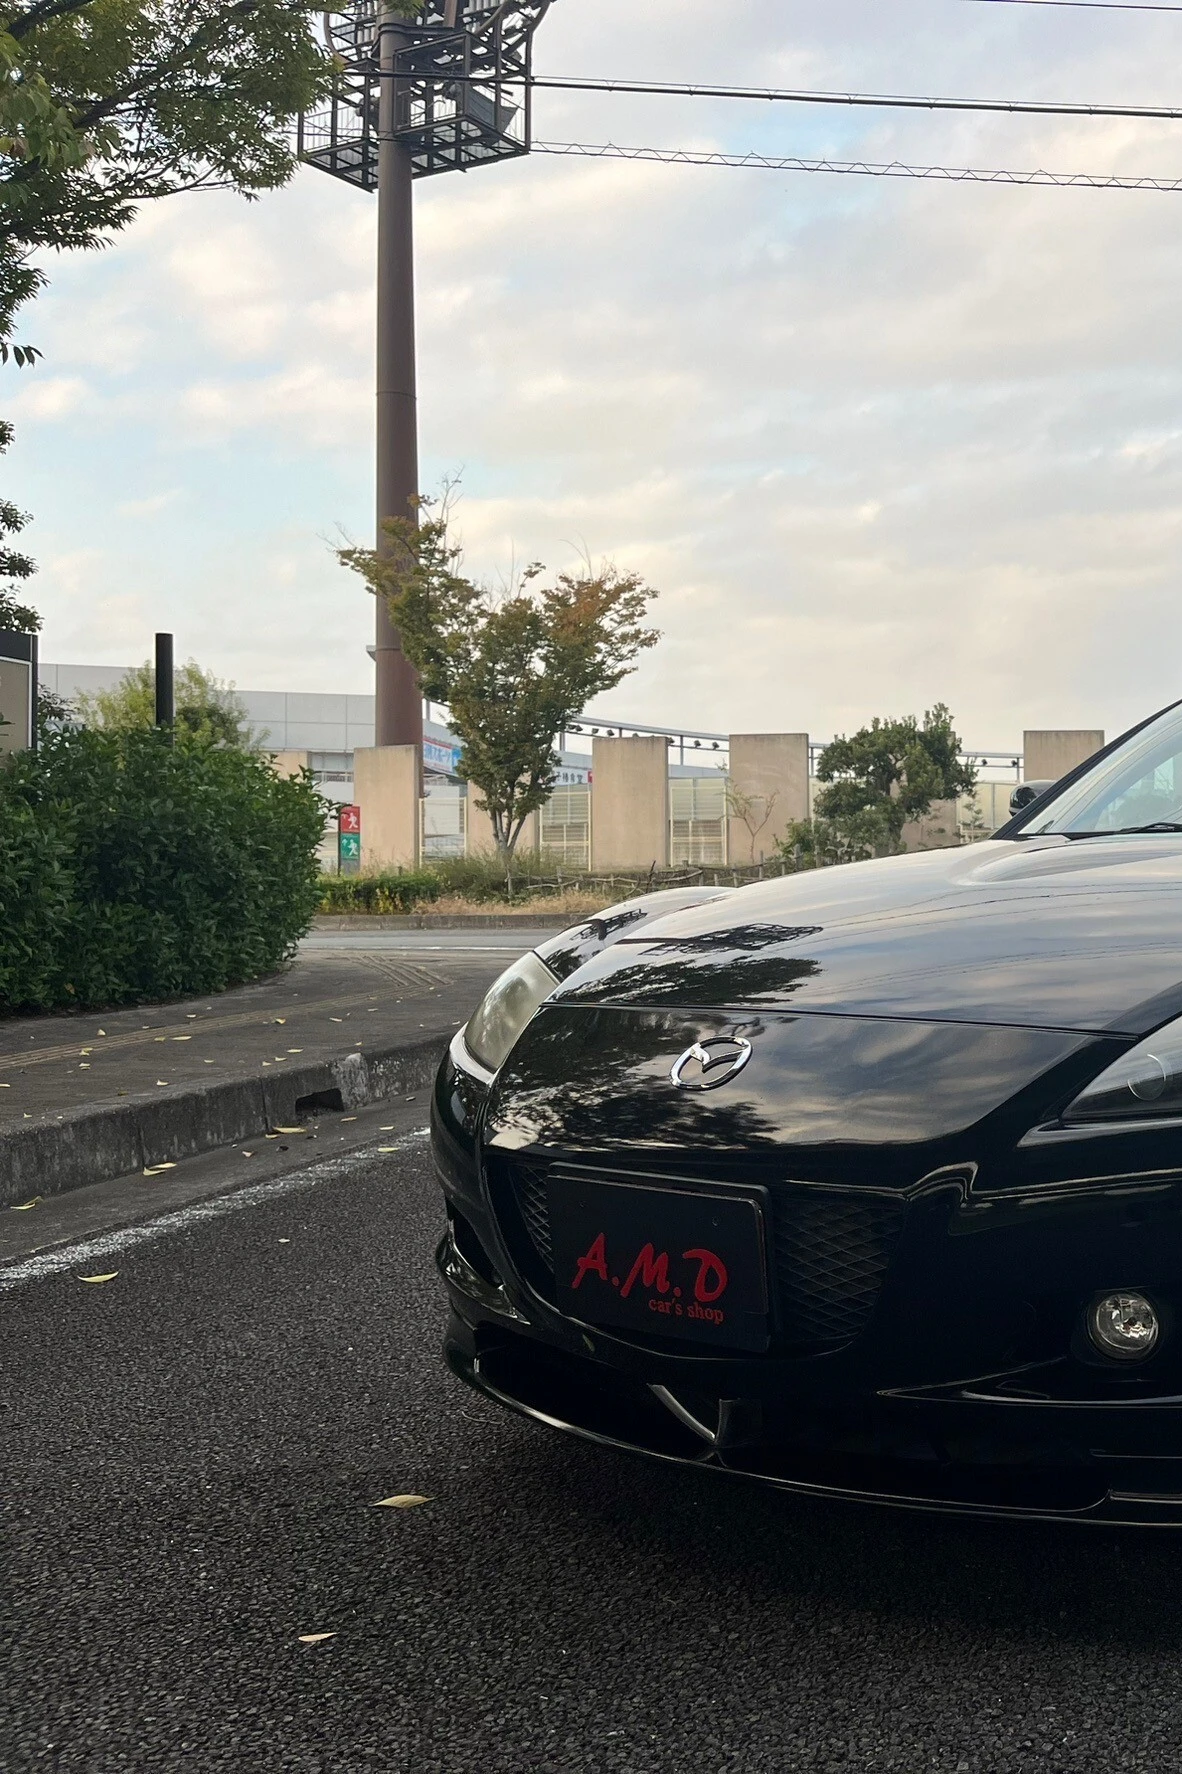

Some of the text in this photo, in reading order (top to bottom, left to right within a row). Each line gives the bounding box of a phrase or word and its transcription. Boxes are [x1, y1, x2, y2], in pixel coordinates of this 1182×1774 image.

[571, 1231, 729, 1303] A.M.D
[648, 1298, 725, 1325] car's shop
